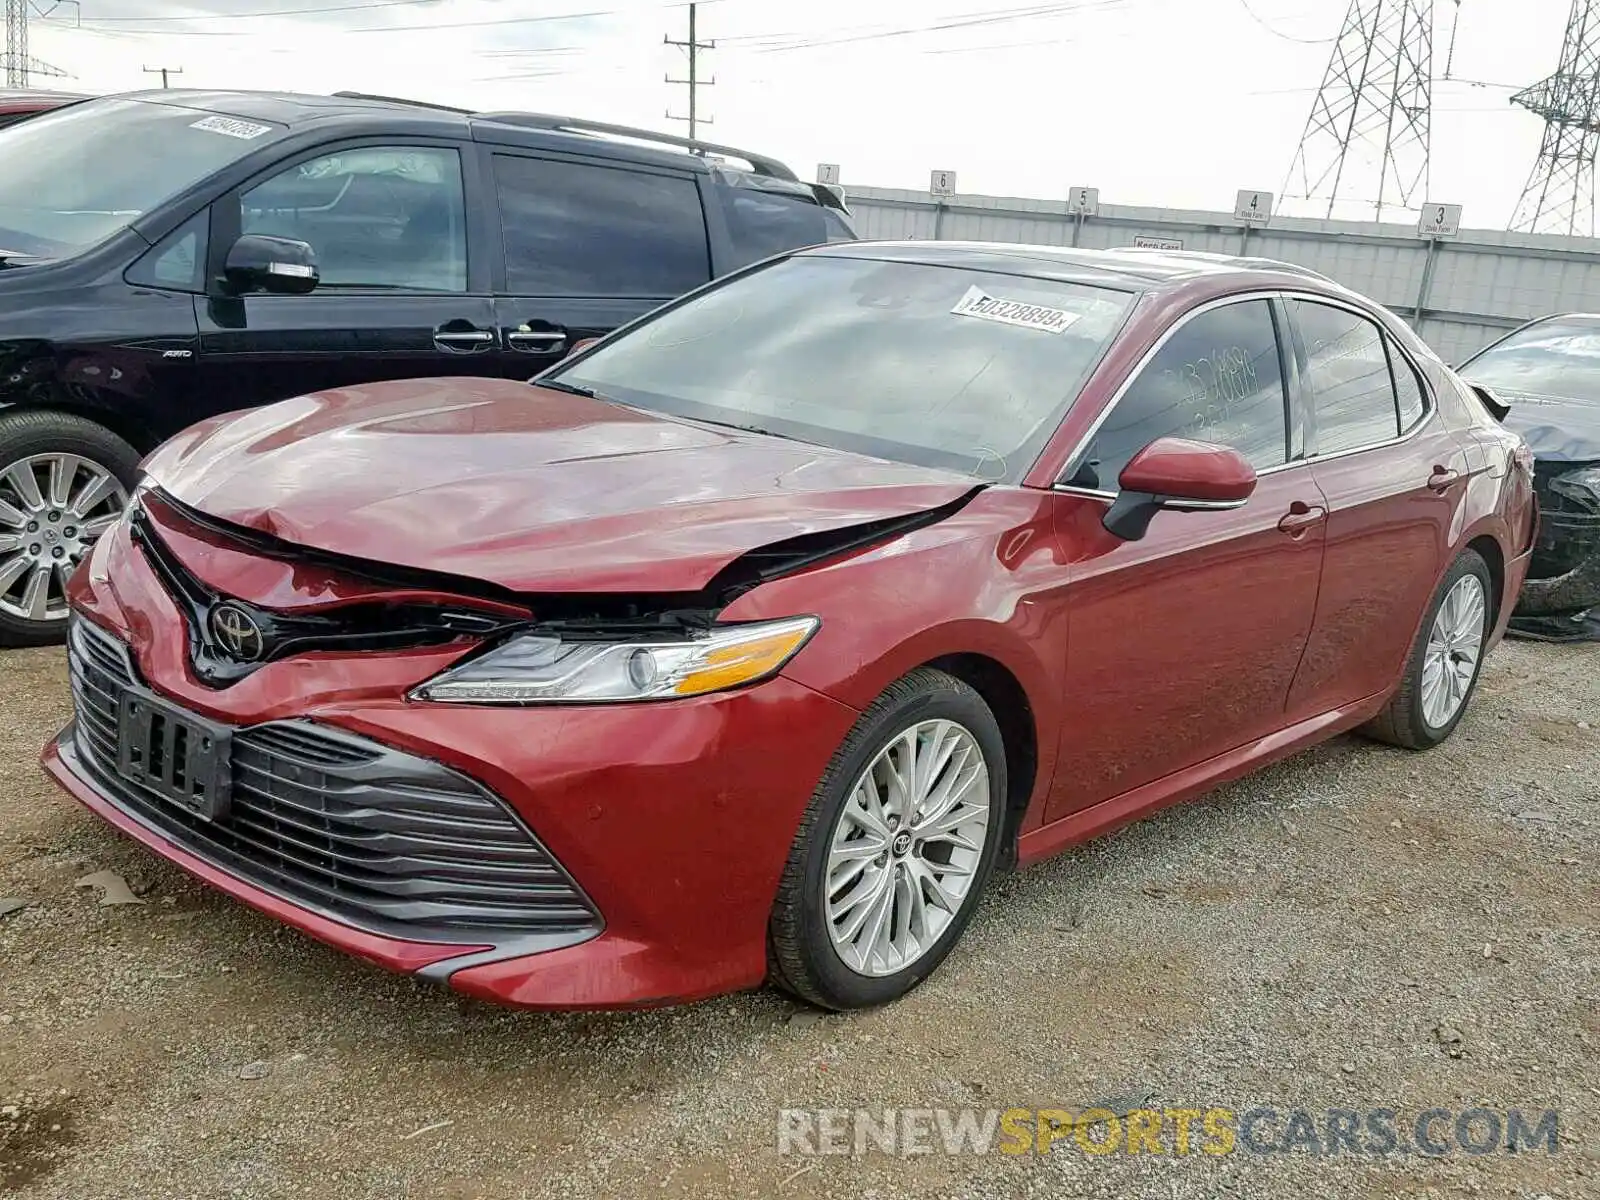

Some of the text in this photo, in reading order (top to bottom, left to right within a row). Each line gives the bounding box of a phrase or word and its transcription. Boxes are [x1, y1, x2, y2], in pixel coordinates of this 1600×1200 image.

[1250, 194, 1258, 212] 4
[1435, 206, 1445, 225] 3
[163, 350, 193, 358] AWD
